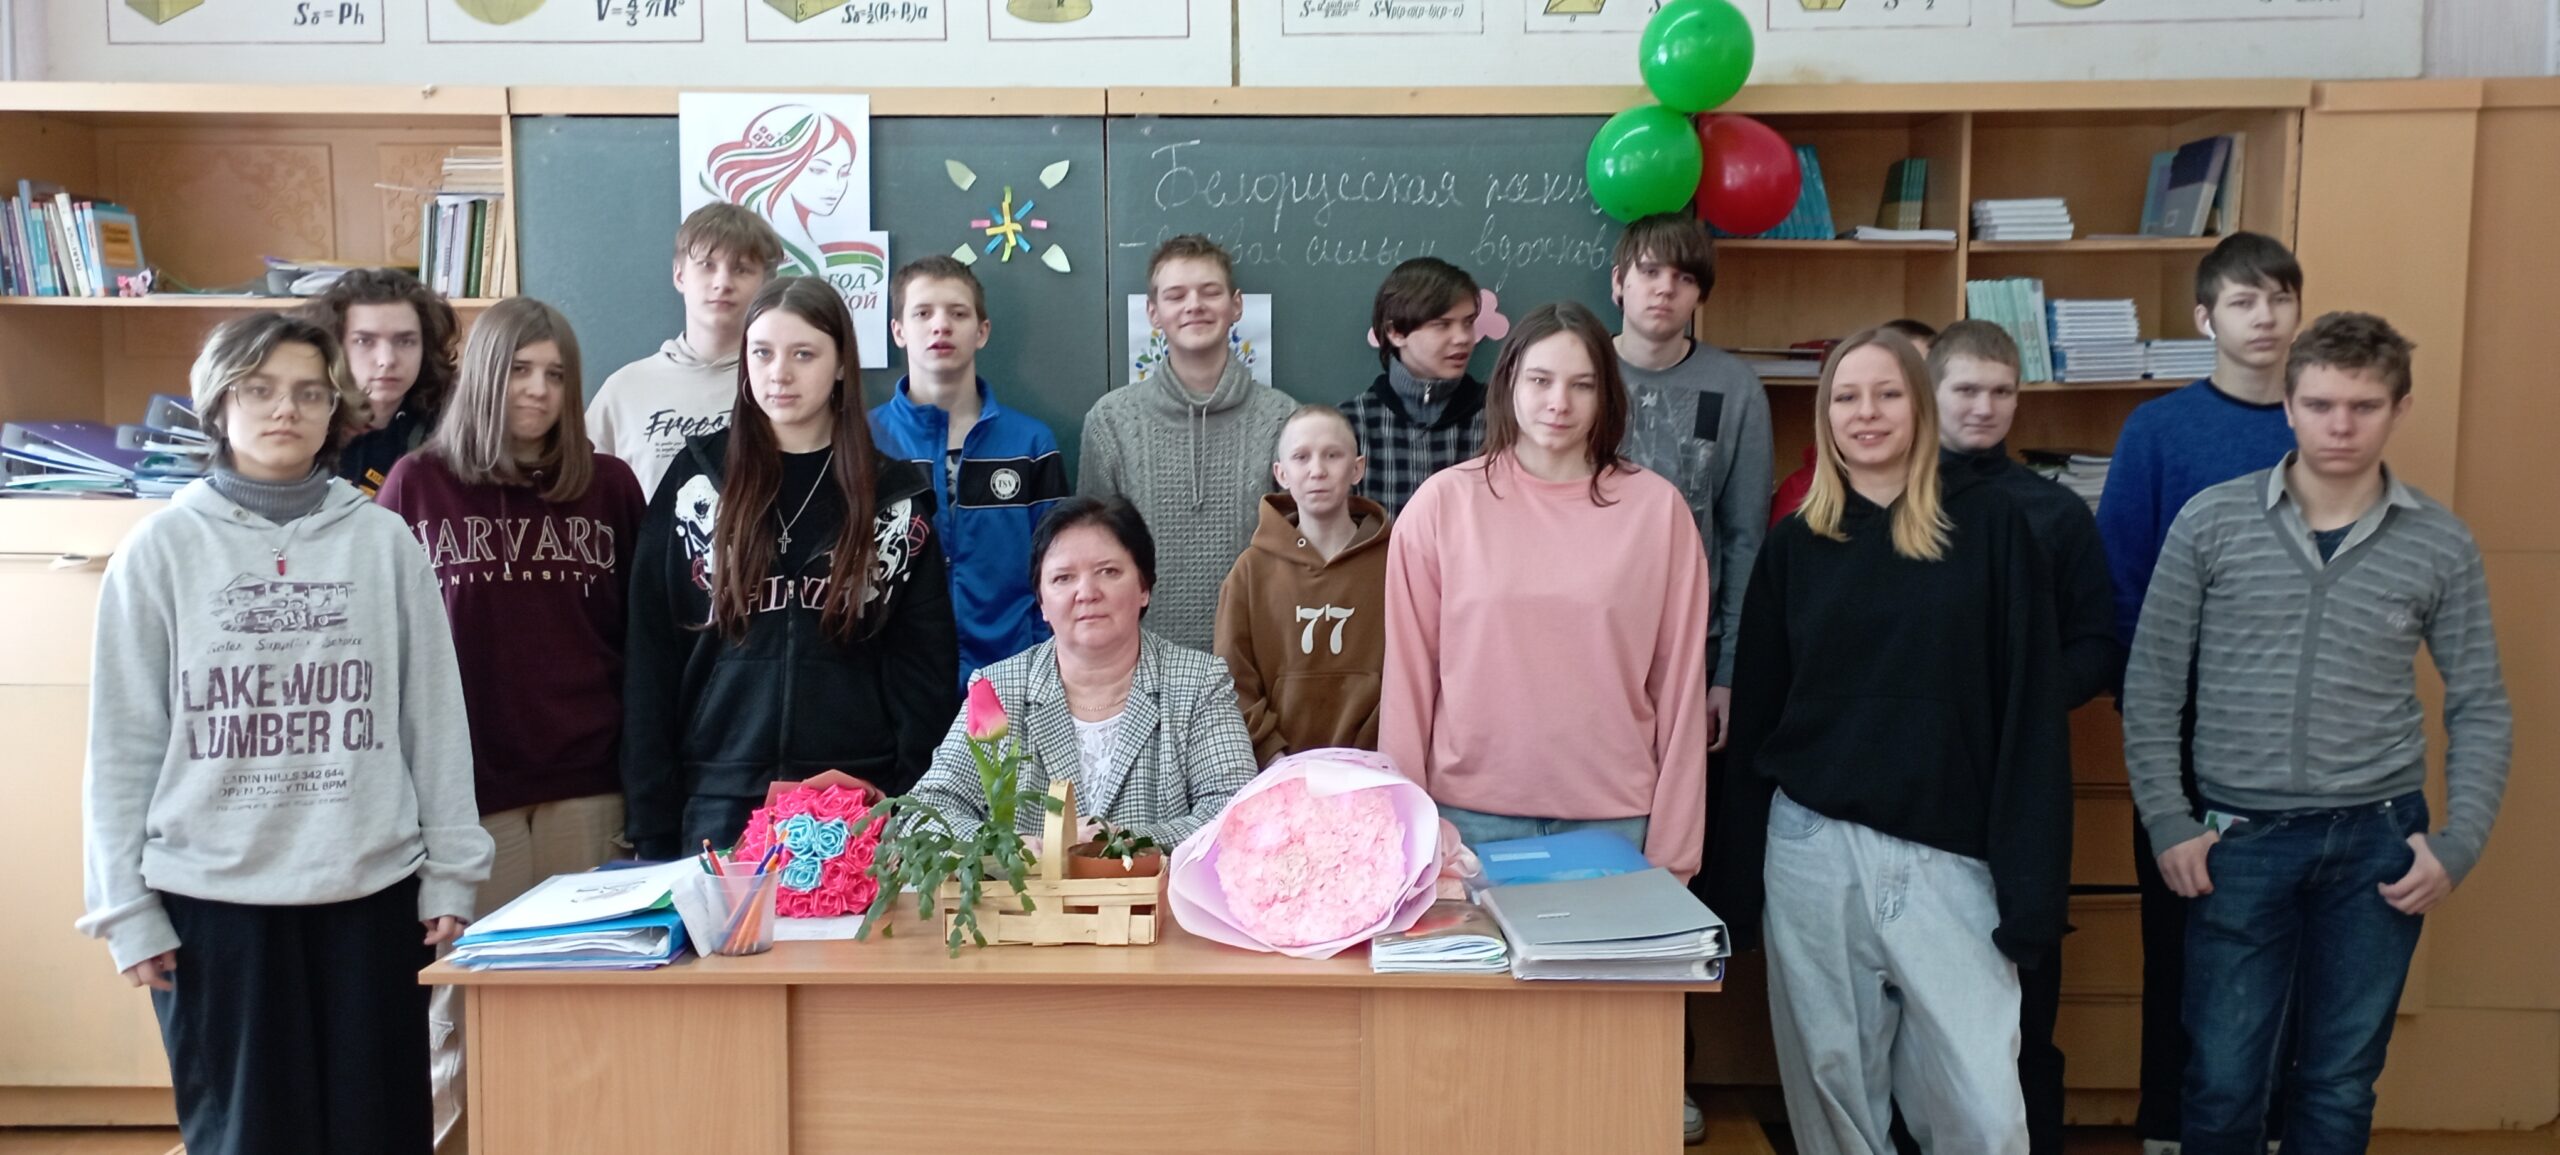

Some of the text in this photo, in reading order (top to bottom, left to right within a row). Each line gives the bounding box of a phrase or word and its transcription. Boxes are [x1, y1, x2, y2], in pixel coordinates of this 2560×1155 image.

[1151, 139, 1464, 233] Белорусская
[1470, 213, 1609, 293] вдохнов
[828, 272, 866, 291] ГОД
[1296, 603, 1355, 655] 77
[185, 708, 331, 760] LUMBER
